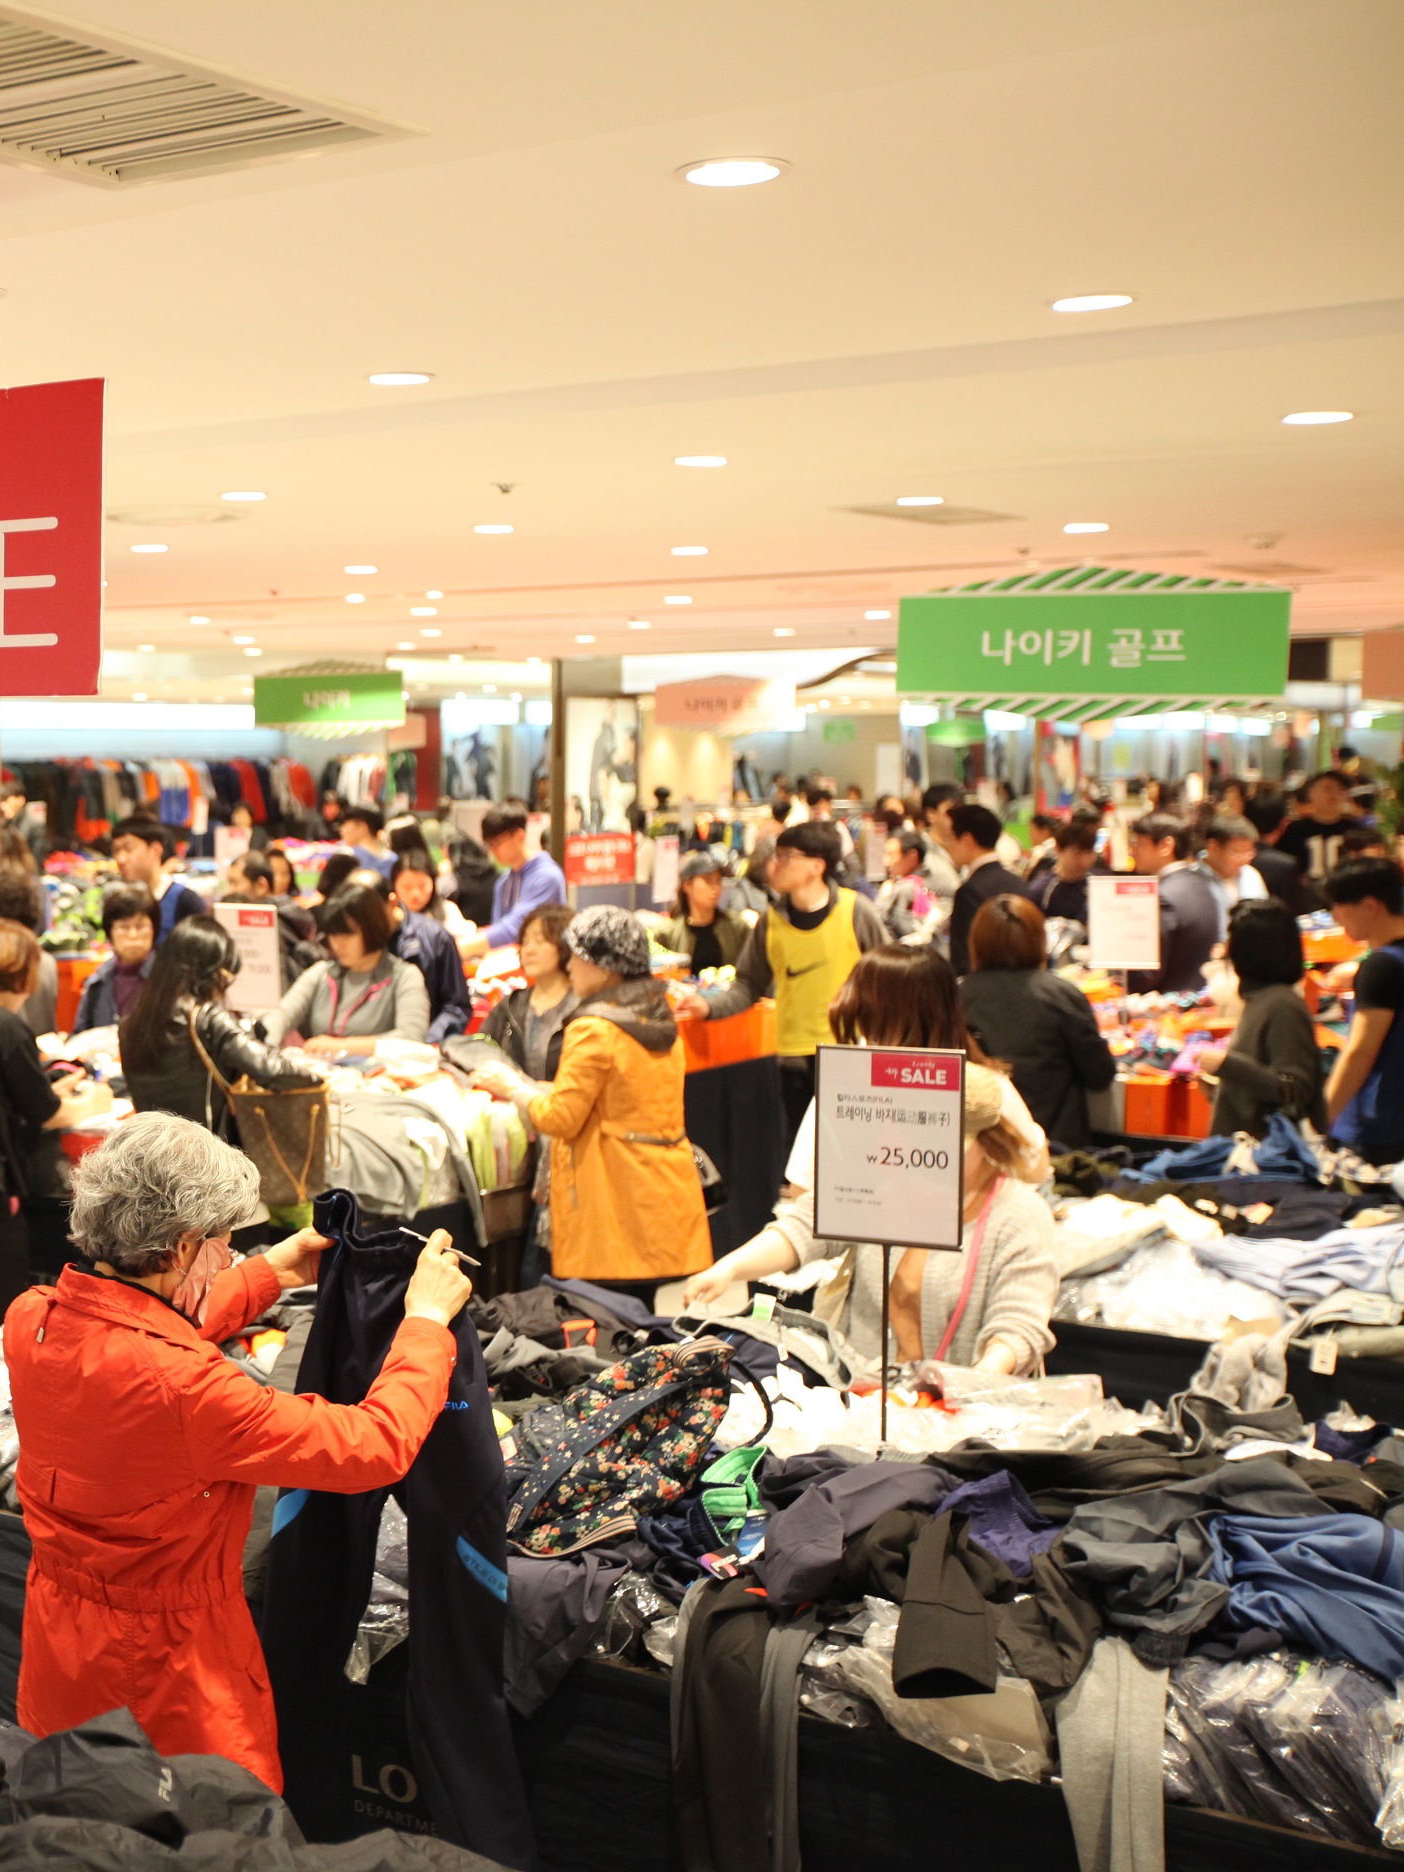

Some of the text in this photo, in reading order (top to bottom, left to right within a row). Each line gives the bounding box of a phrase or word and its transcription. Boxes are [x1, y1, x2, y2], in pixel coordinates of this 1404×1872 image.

[981, 629, 1187, 668] 나이키 골프
[302, 689, 351, 710] 나이키
[900, 1067, 948, 1086] SALE
[836, 1105, 873, 1123] 트레이닝
[158, 1766, 173, 1802] FILA
[354, 1798, 439, 1837] DEPARTME
